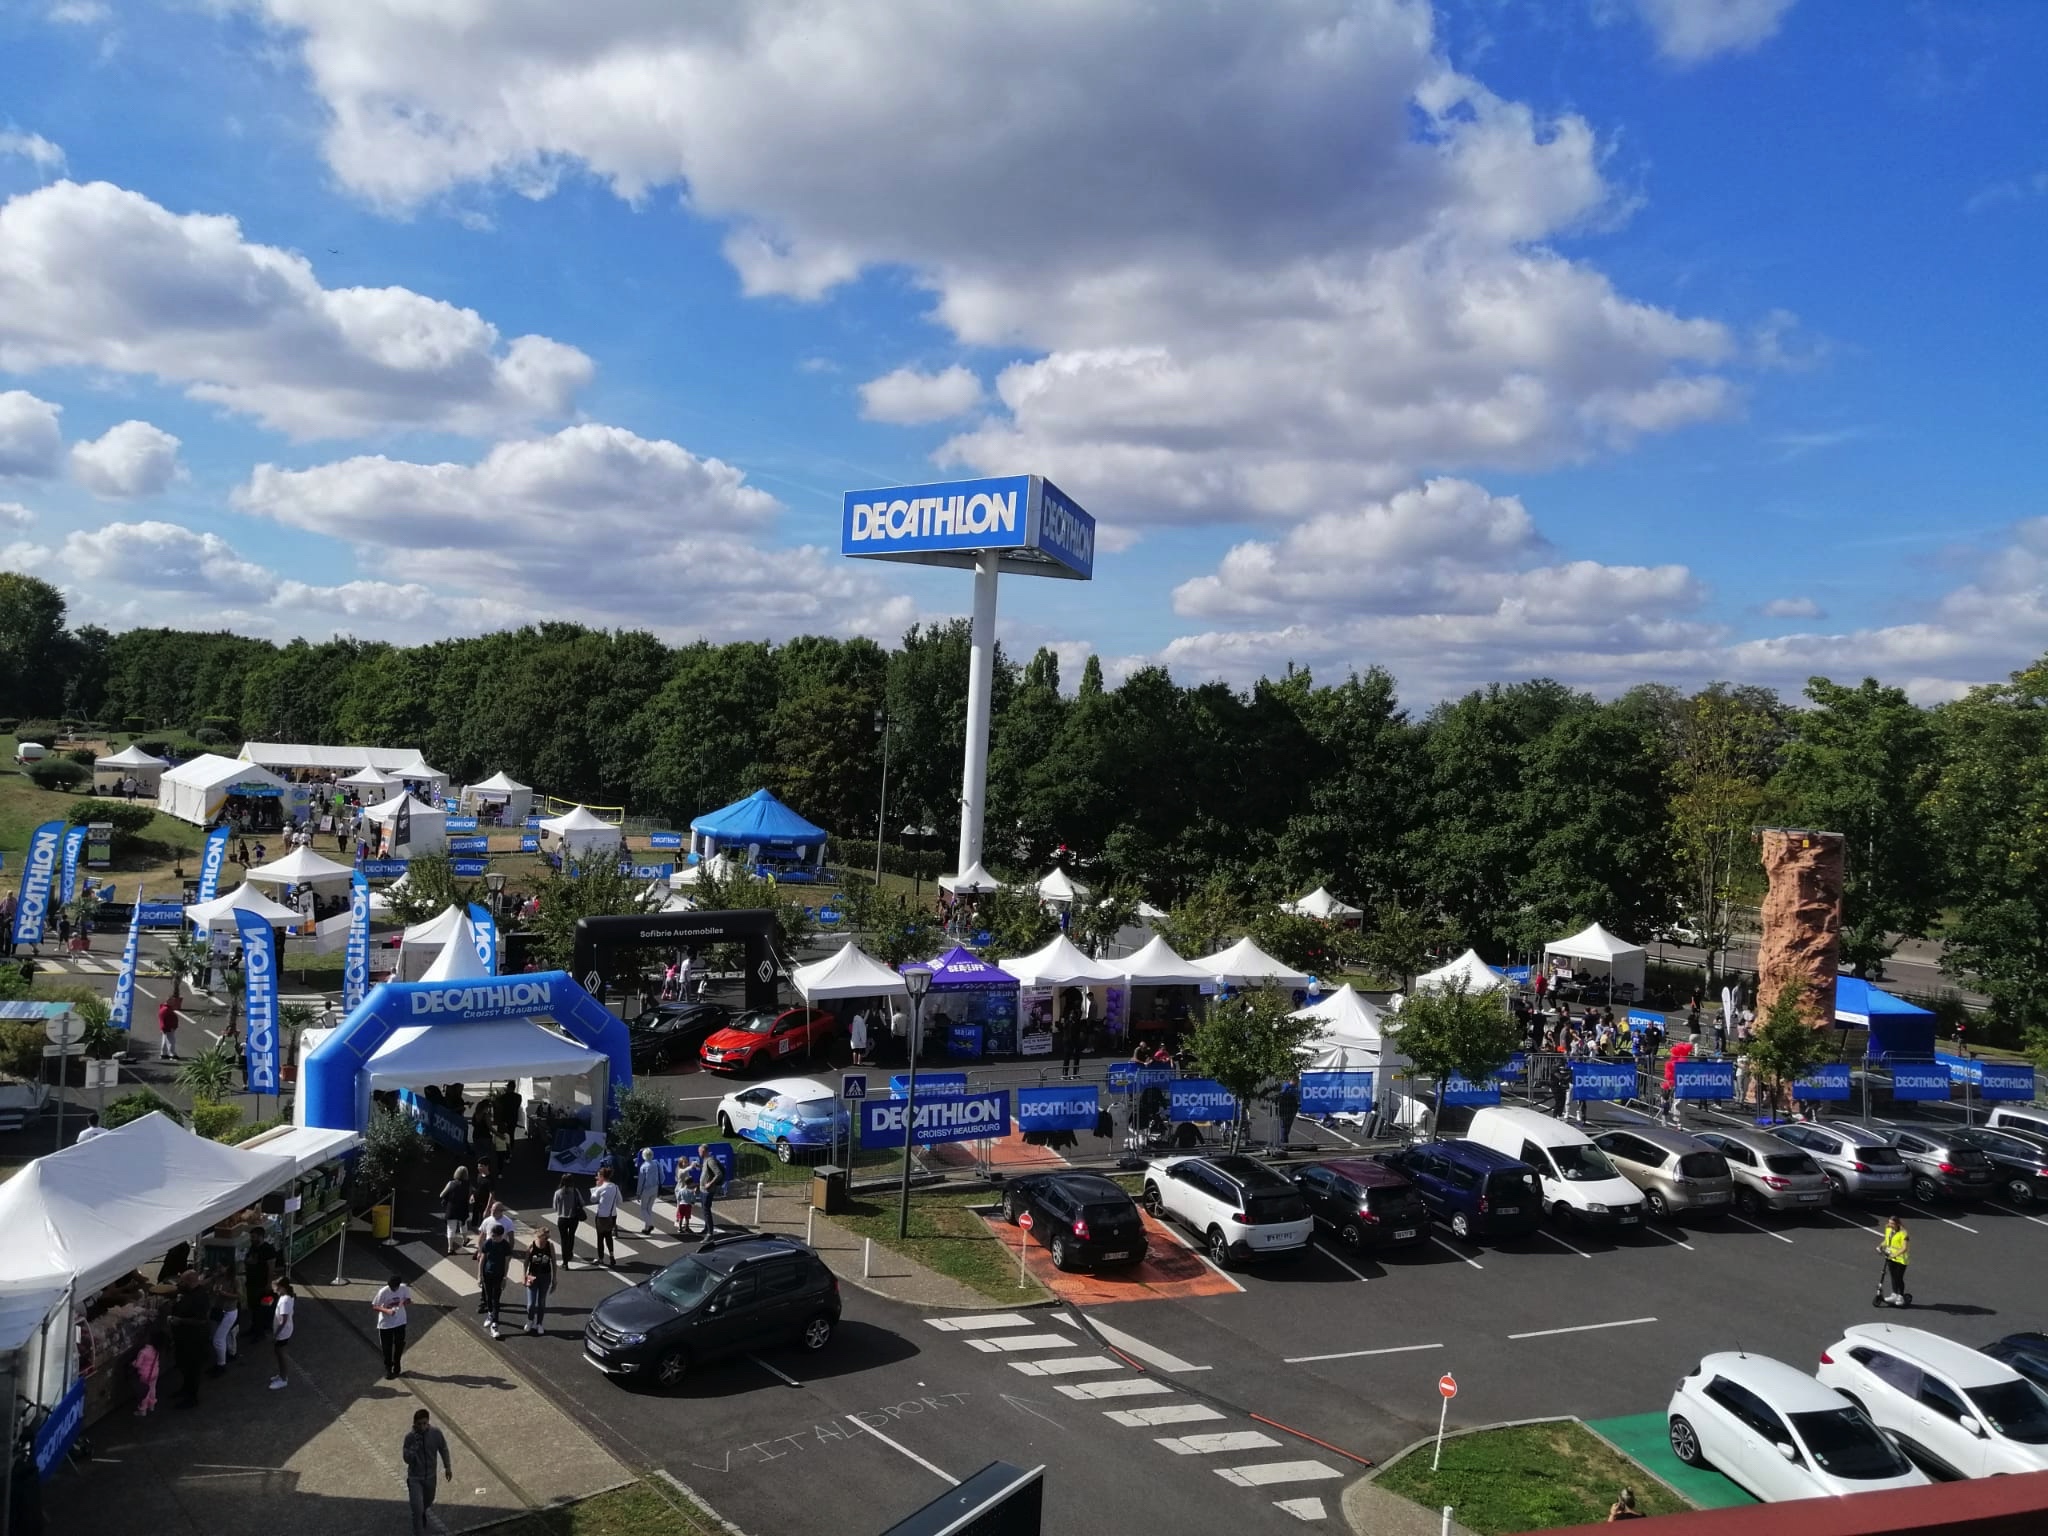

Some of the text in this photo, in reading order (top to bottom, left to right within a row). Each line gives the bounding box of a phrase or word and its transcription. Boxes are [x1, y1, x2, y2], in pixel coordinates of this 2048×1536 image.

[852, 491, 1018, 541] DECATHLON
[1042, 496, 1093, 565] DECATHLON
[18, 831, 58, 939] DECATHLON
[640, 927, 723, 938] Sofibrie Automobiles
[411, 981, 550, 1015] DECATHLON
[243, 927, 274, 1088] DECATHLON
[463, 1009, 500, 1018] CROISSY
[1575, 1074, 1635, 1088] DECATHLON
[1677, 1073, 1732, 1087] DECATHLON
[1895, 1076, 1949, 1089] DECATHLON
[1983, 1076, 2033, 1089] DECATHLON
[1172, 1092, 1234, 1107] DECATHLO
[1302, 1086, 1371, 1099] DECATHLON
[872, 1098, 1001, 1131] DECATHLON
[1021, 1100, 1096, 1118] DECATHLON
[917, 1123, 1001, 1139] CROISSY BEAUBOURG
